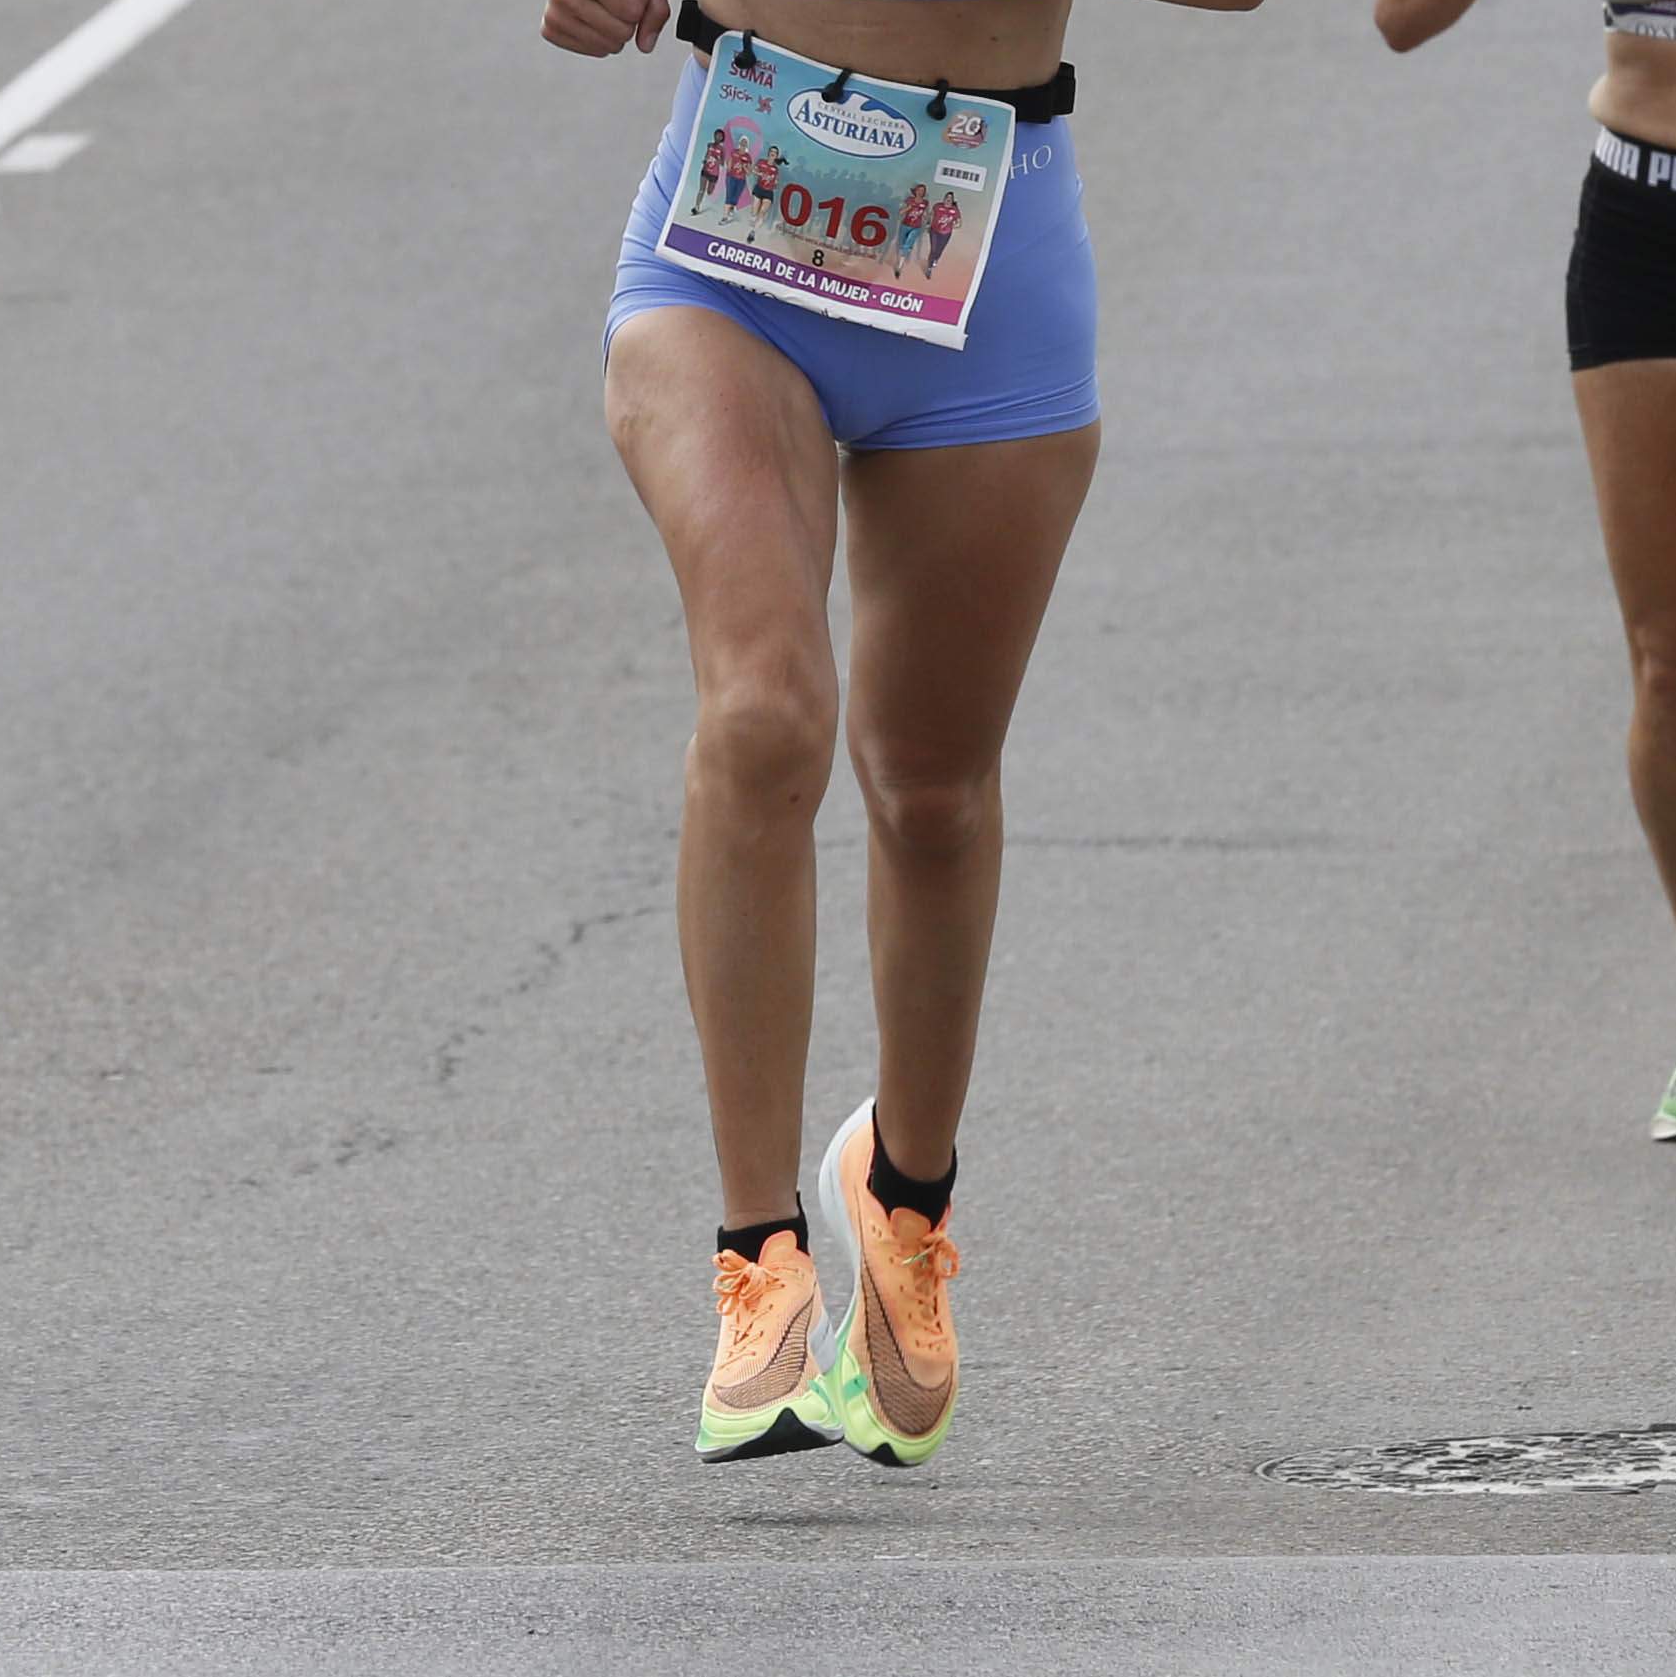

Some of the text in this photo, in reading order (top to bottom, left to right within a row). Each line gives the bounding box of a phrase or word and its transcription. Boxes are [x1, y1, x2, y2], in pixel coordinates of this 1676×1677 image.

[794, 99, 905, 149] ASTURIANA
[780, 183, 890, 247] 016
[707, 241, 924, 313] CARRERA DE LA MUJER GIJÓN
[812, 249, 825, 267] 8
